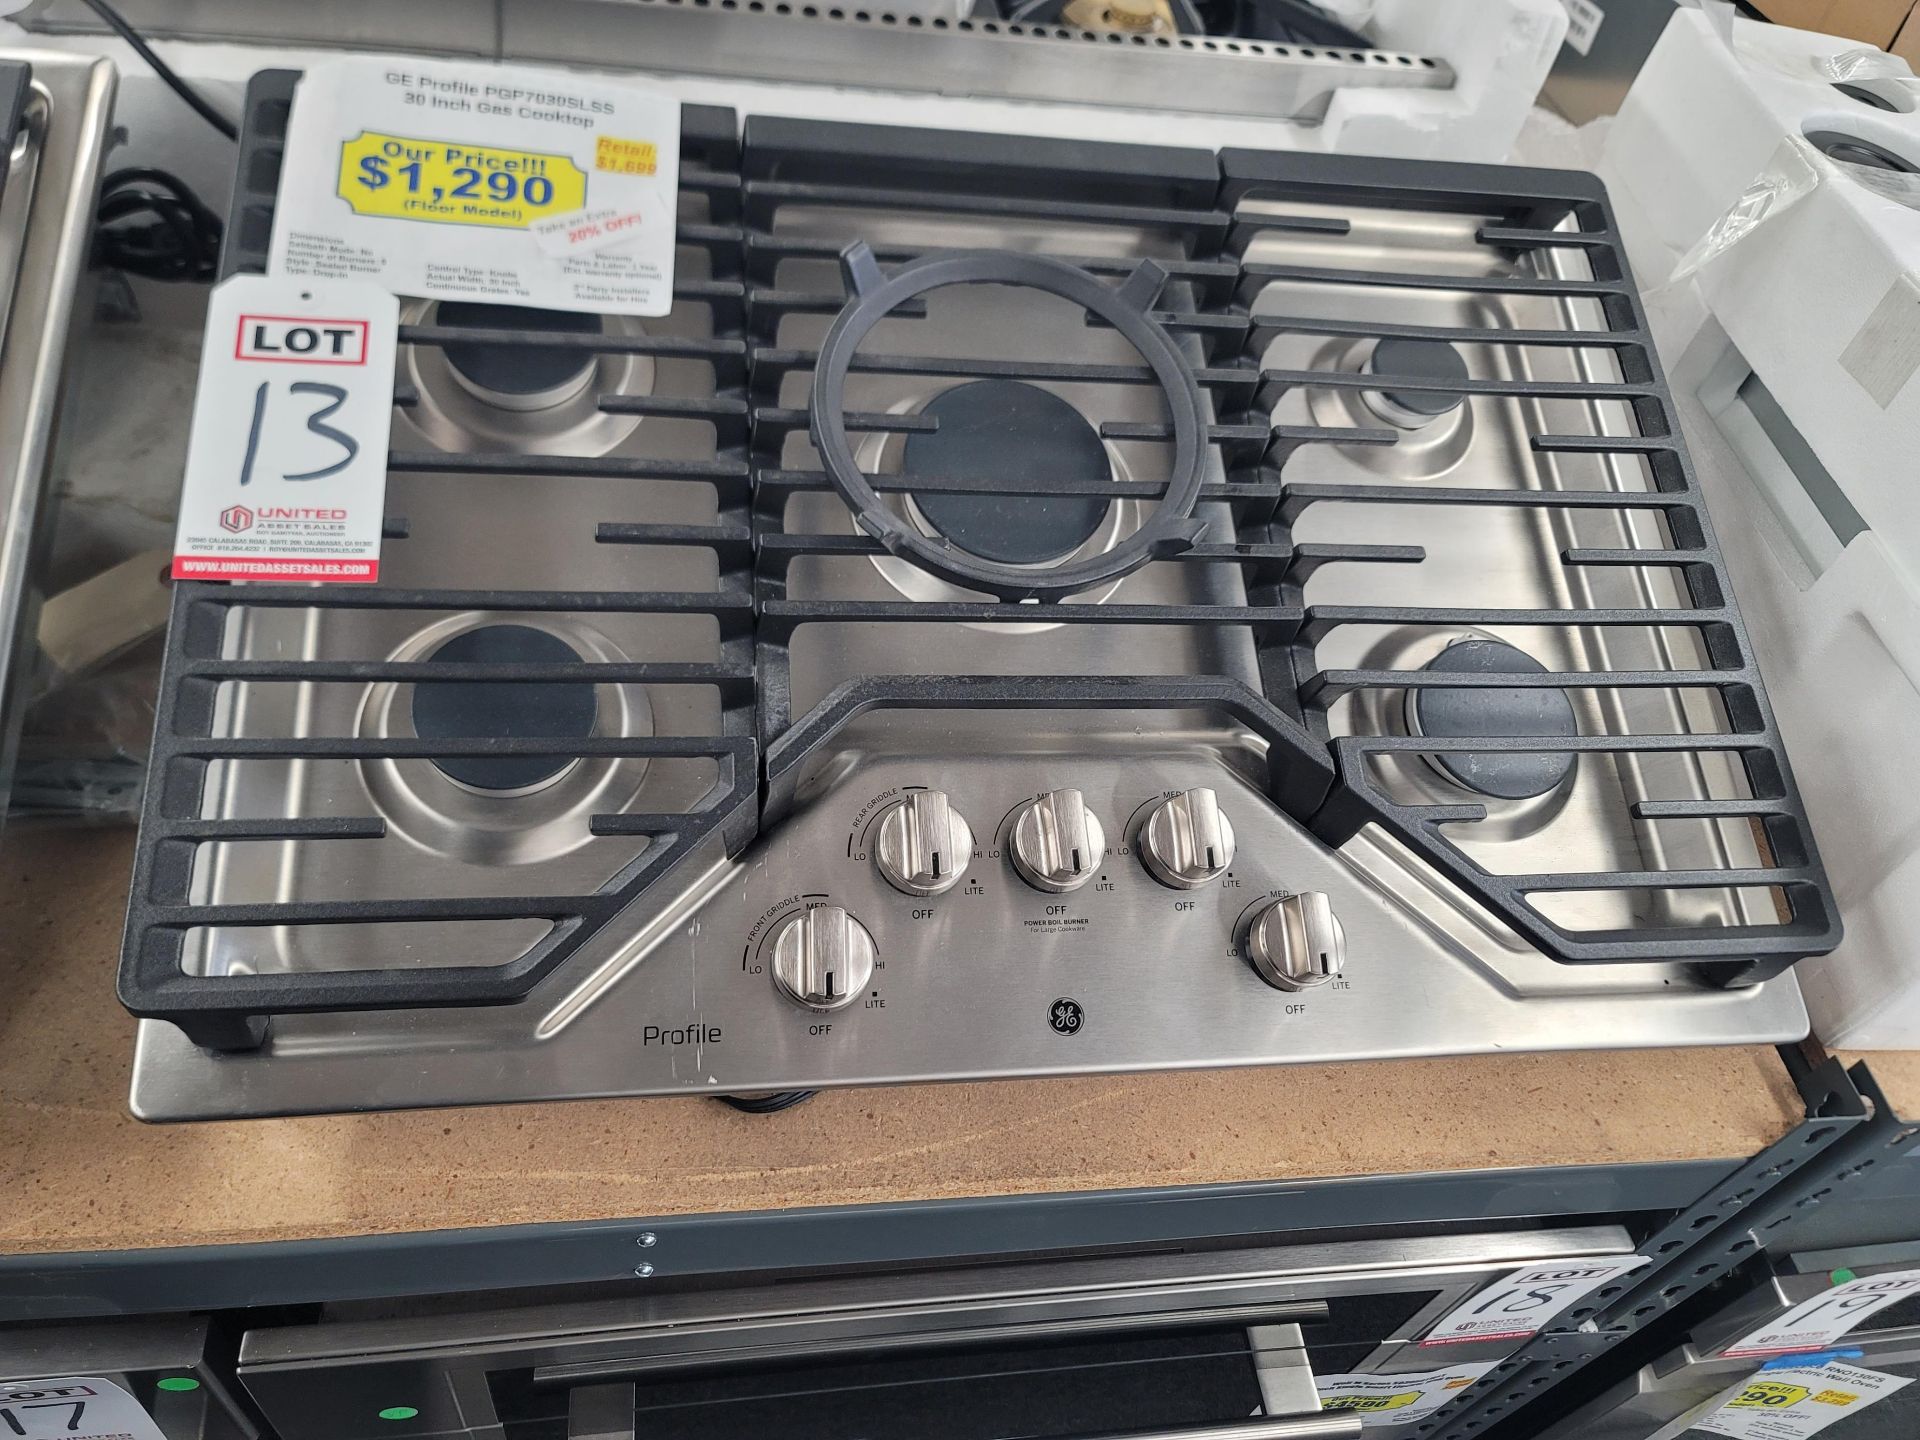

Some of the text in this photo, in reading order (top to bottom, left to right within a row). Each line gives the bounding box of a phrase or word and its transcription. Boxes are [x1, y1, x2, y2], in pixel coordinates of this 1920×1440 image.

[386, 72, 412, 86] GE
[420, 76, 479, 97] Profile
[404, 92, 594, 129] 30 Inch Gas Cooktop
[383, 141, 546, 176] Our Price!!!
[357, 155, 554, 207] $1,290
[404, 199, 523, 221] (Floor Model)
[568, 226, 602, 243] 20%
[253, 326, 356, 354] LOT
[240, 381, 360, 487] 13
[257, 507, 347, 520] UNITED
[182, 561, 370, 575] WWW.UNITEDASSETSALES.COM
[852, 788, 898, 828] REAR GRIDDLE
[964, 887, 984, 895] LITE
[1222, 880, 1241, 888] LITE
[1046, 905, 1067, 915] OFF
[1174, 902, 1195, 911] OFF
[747, 894, 800, 942] FRONT GRIDDLE
[912, 910, 934, 919] OFF
[749, 965, 763, 975] LO
[875, 961, 885, 970] HI
[865, 1000, 886, 1009] LITE
[1285, 1004, 1306, 1014] OFF
[643, 1023, 722, 1047] Profile
[809, 1025, 832, 1035] OFF
[1531, 1269, 1601, 1280] LOT
[1850, 1280, 1919, 1292] LOT
[1472, 1284, 1574, 1314] 18
[1784, 1294, 1888, 1328] 19
[1479, 1316, 1533, 1325] UNITED
[1748, 1383, 1797, 1394] rice!!!
[1825, 1373, 1849, 1383] Wall
[1851, 1380, 1880, 1390] Oven
[1742, 1390, 1788, 1405] 90
